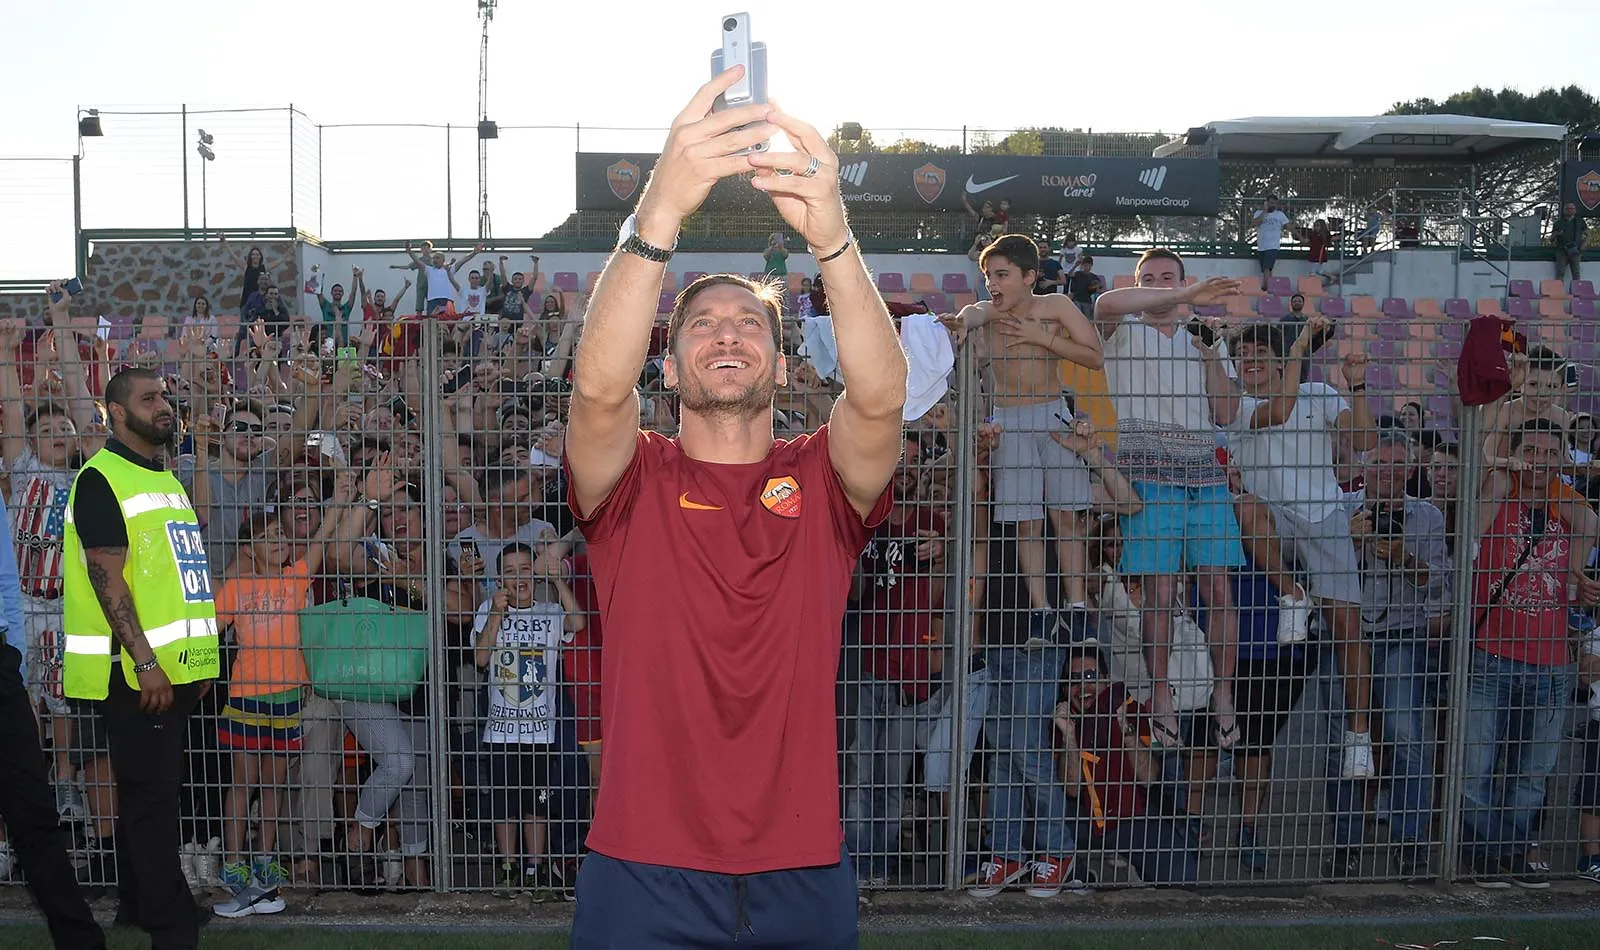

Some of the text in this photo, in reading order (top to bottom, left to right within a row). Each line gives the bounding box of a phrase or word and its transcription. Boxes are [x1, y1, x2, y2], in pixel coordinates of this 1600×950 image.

[1041, 175, 1081, 187] ROMA
[841, 192, 892, 204] owerGroup
[1063, 186, 1096, 198] Cares
[1115, 196, 1190, 208] ManpowerGroup
[17, 528, 64, 553] BROOKL
[500, 617, 552, 633] UGBY
[519, 719, 550, 735] CLUB
